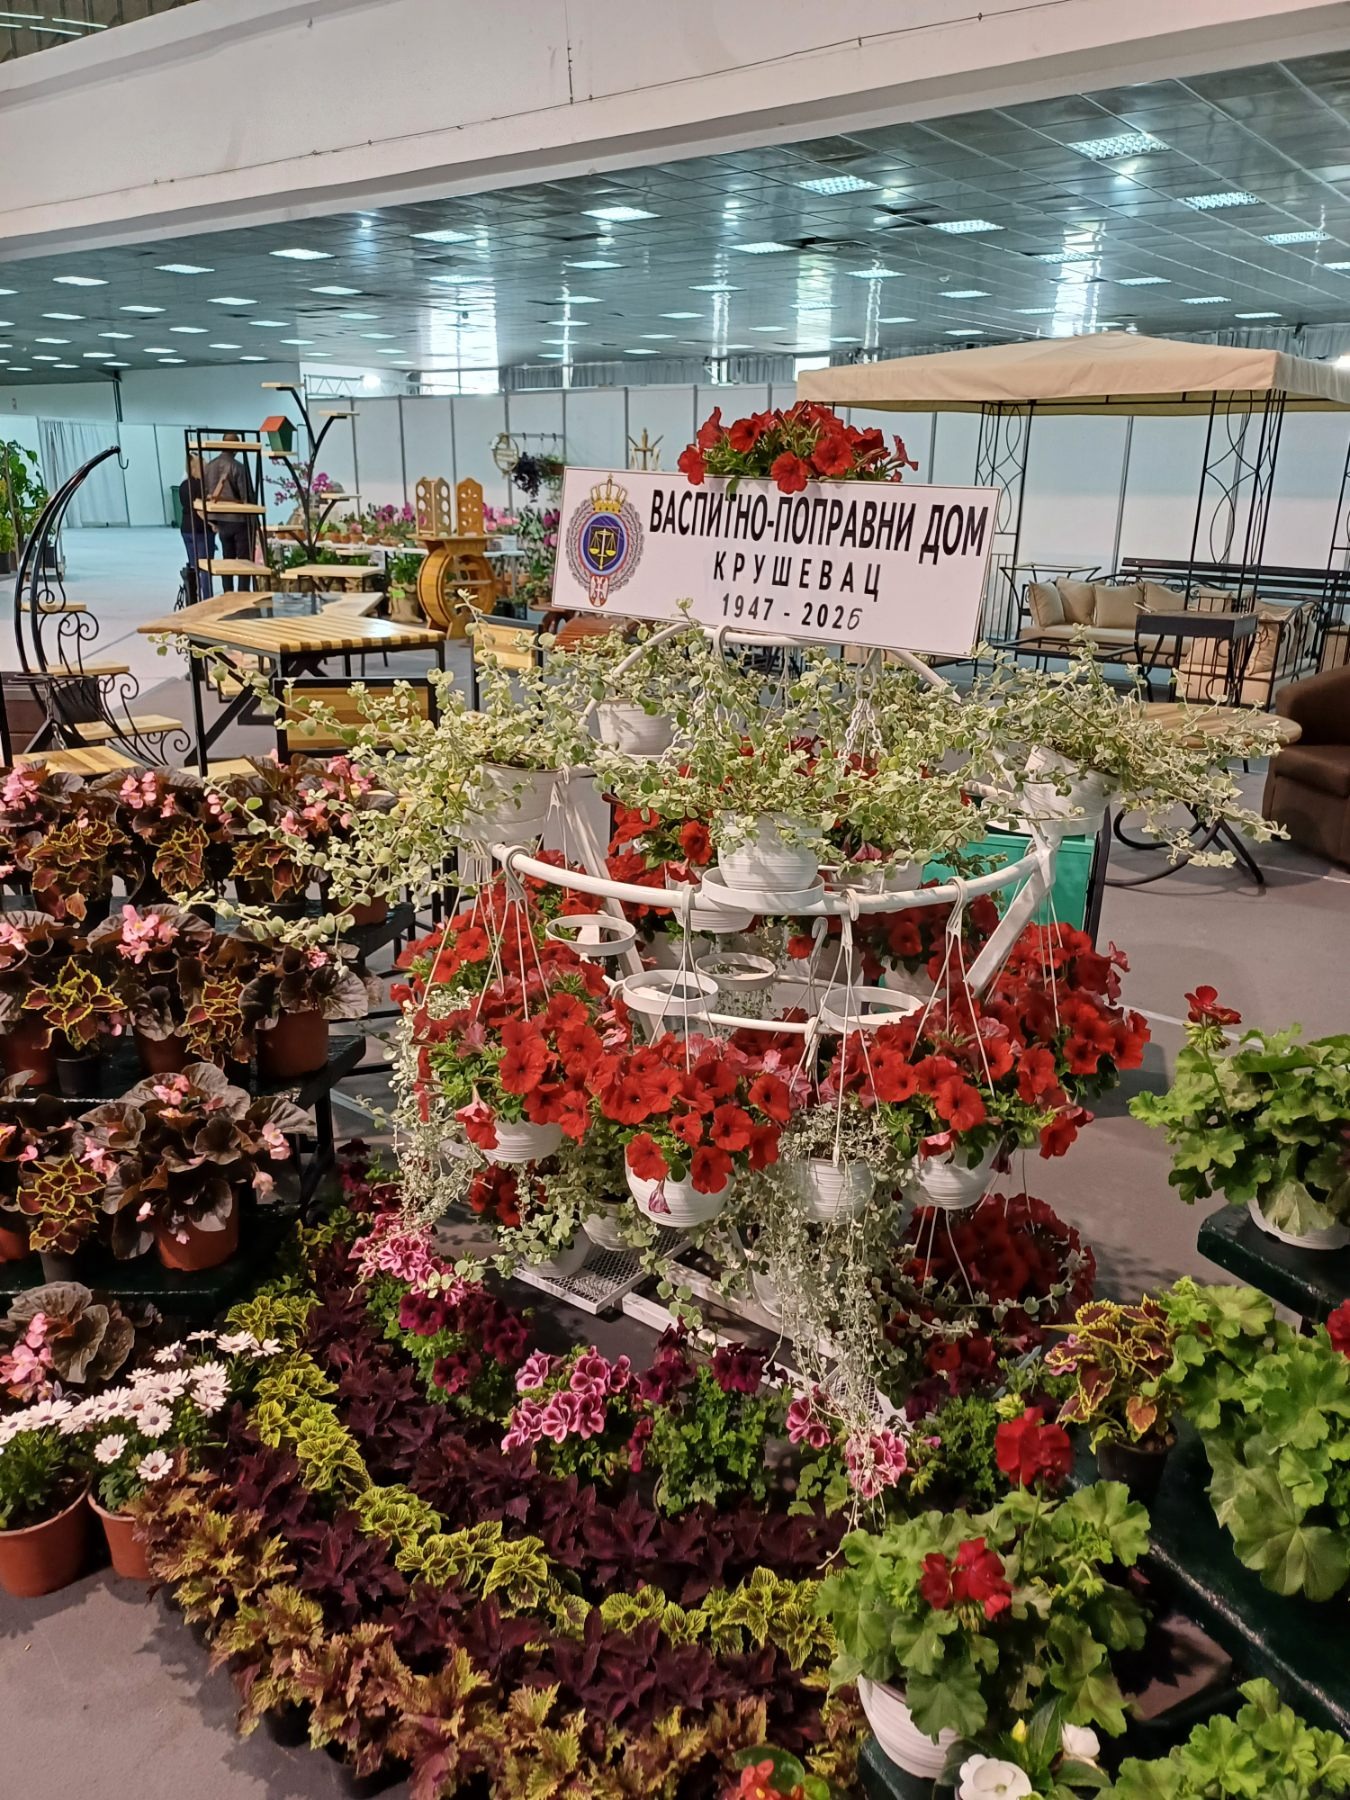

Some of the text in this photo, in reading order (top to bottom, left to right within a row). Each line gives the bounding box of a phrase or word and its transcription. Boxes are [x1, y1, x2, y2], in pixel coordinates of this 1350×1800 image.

[650, 489, 988, 565] ВАСПИТНО-ПОПРАВНИ ДОМ
[713, 551, 881, 602] КРУШЕВАЦ
[722, 593, 774, 621] 1947
[801, 602, 863, 630] 2026
